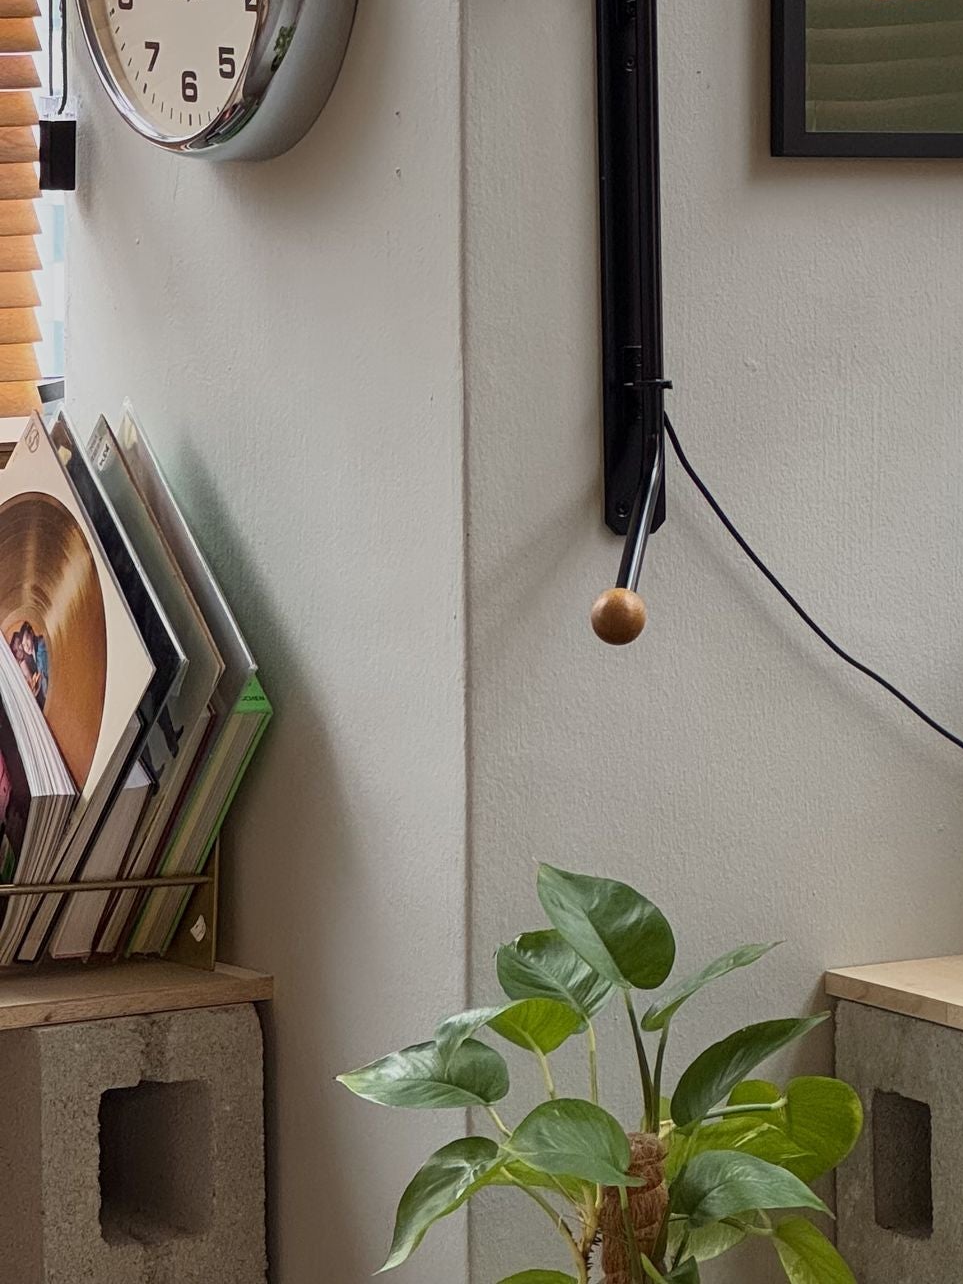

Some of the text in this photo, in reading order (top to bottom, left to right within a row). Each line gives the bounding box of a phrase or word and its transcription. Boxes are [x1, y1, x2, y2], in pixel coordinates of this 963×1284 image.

[144, 42, 160, 72] 7
[218, 47, 236, 79] 5
[181, 71, 197, 102] 6
